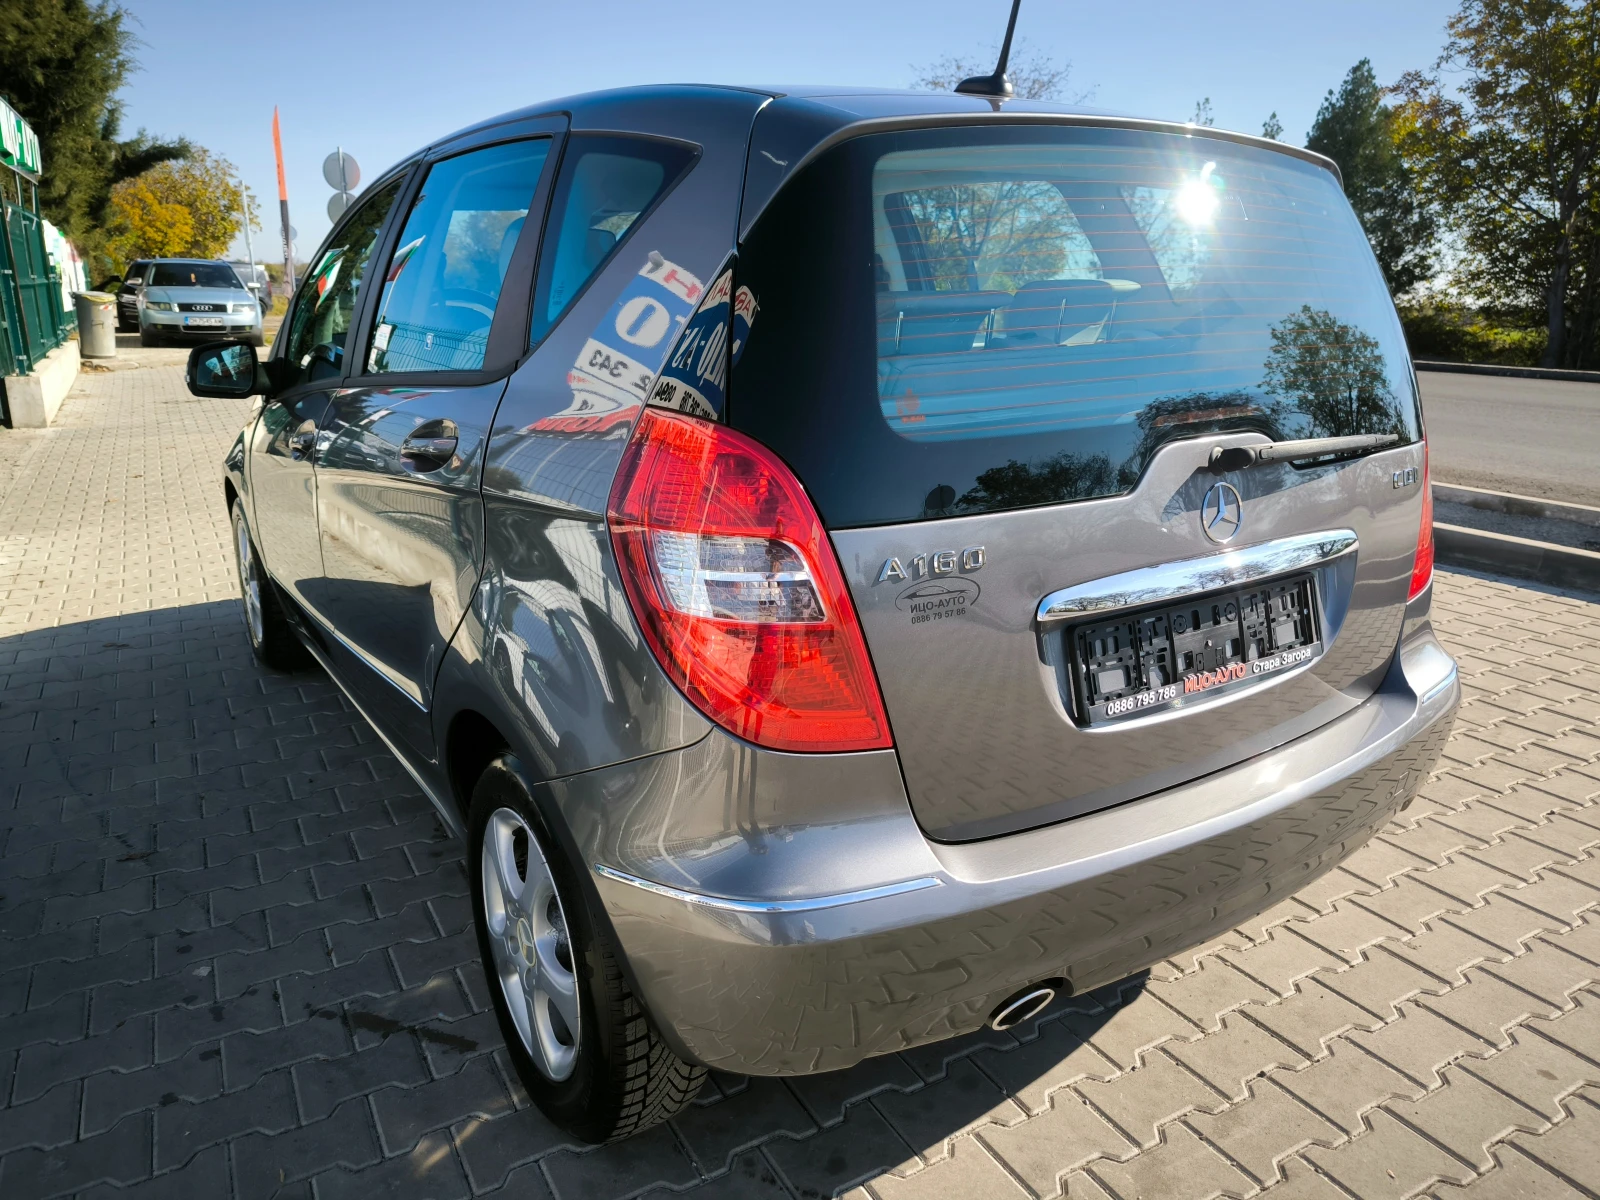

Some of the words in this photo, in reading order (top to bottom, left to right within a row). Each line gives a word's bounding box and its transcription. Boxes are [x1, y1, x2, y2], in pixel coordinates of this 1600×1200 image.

[910, 595, 965, 613] ИЦО-АУТО
[911, 613, 931, 624] 0886
[933, 611, 943, 620] 79
[944, 609, 954, 618] 57
[956, 607, 966, 615] 86
[1107, 697, 1134, 715] 0886
[1136, 692, 1155, 708] 795
[1157, 686, 1176, 701] 786
[1184, 664, 1247, 694] ИЦО-АУТО
[1252, 658, 1280, 674] Стара
[1281, 648, 1311, 665] Загора
